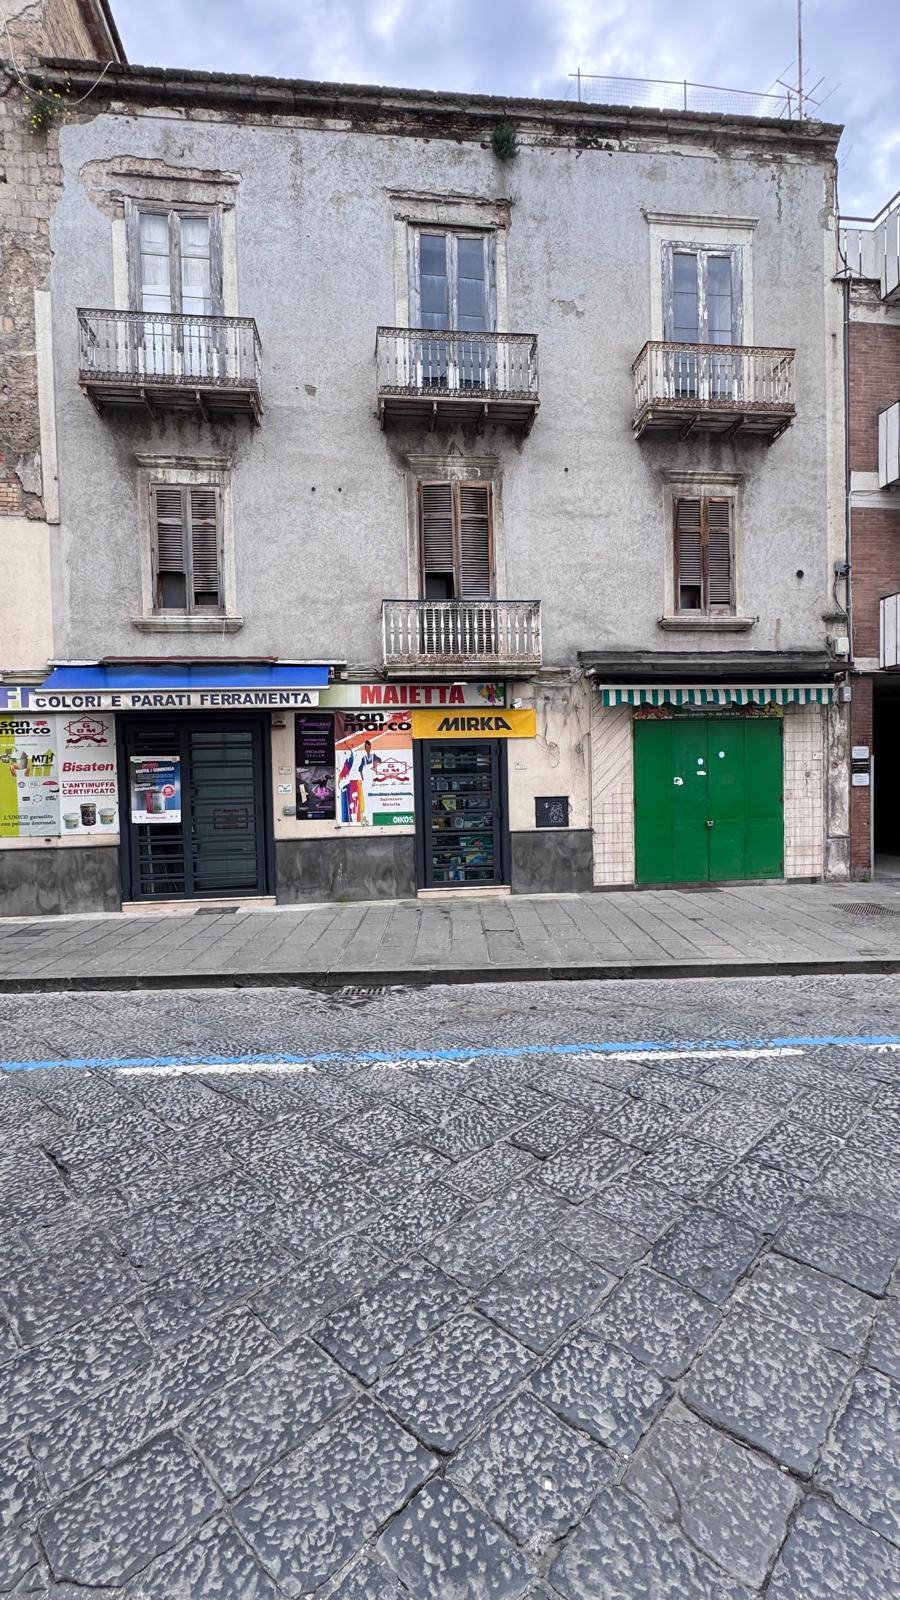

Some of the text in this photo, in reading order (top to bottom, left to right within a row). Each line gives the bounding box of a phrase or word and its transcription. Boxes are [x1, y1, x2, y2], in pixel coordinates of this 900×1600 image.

[360, 685, 465, 704] MAIETTA
[36, 692, 312, 708] COLORI E PARATI FERRAMENTA
[344, 712, 384, 722] san
[0, 720, 30, 728] san
[344, 722, 412, 731] marco
[437, 717, 512, 732] MIRKA
[0, 727, 50, 735] marco
[62, 762, 114, 772] Bisaten
[392, 816, 413, 824] OIKOS
